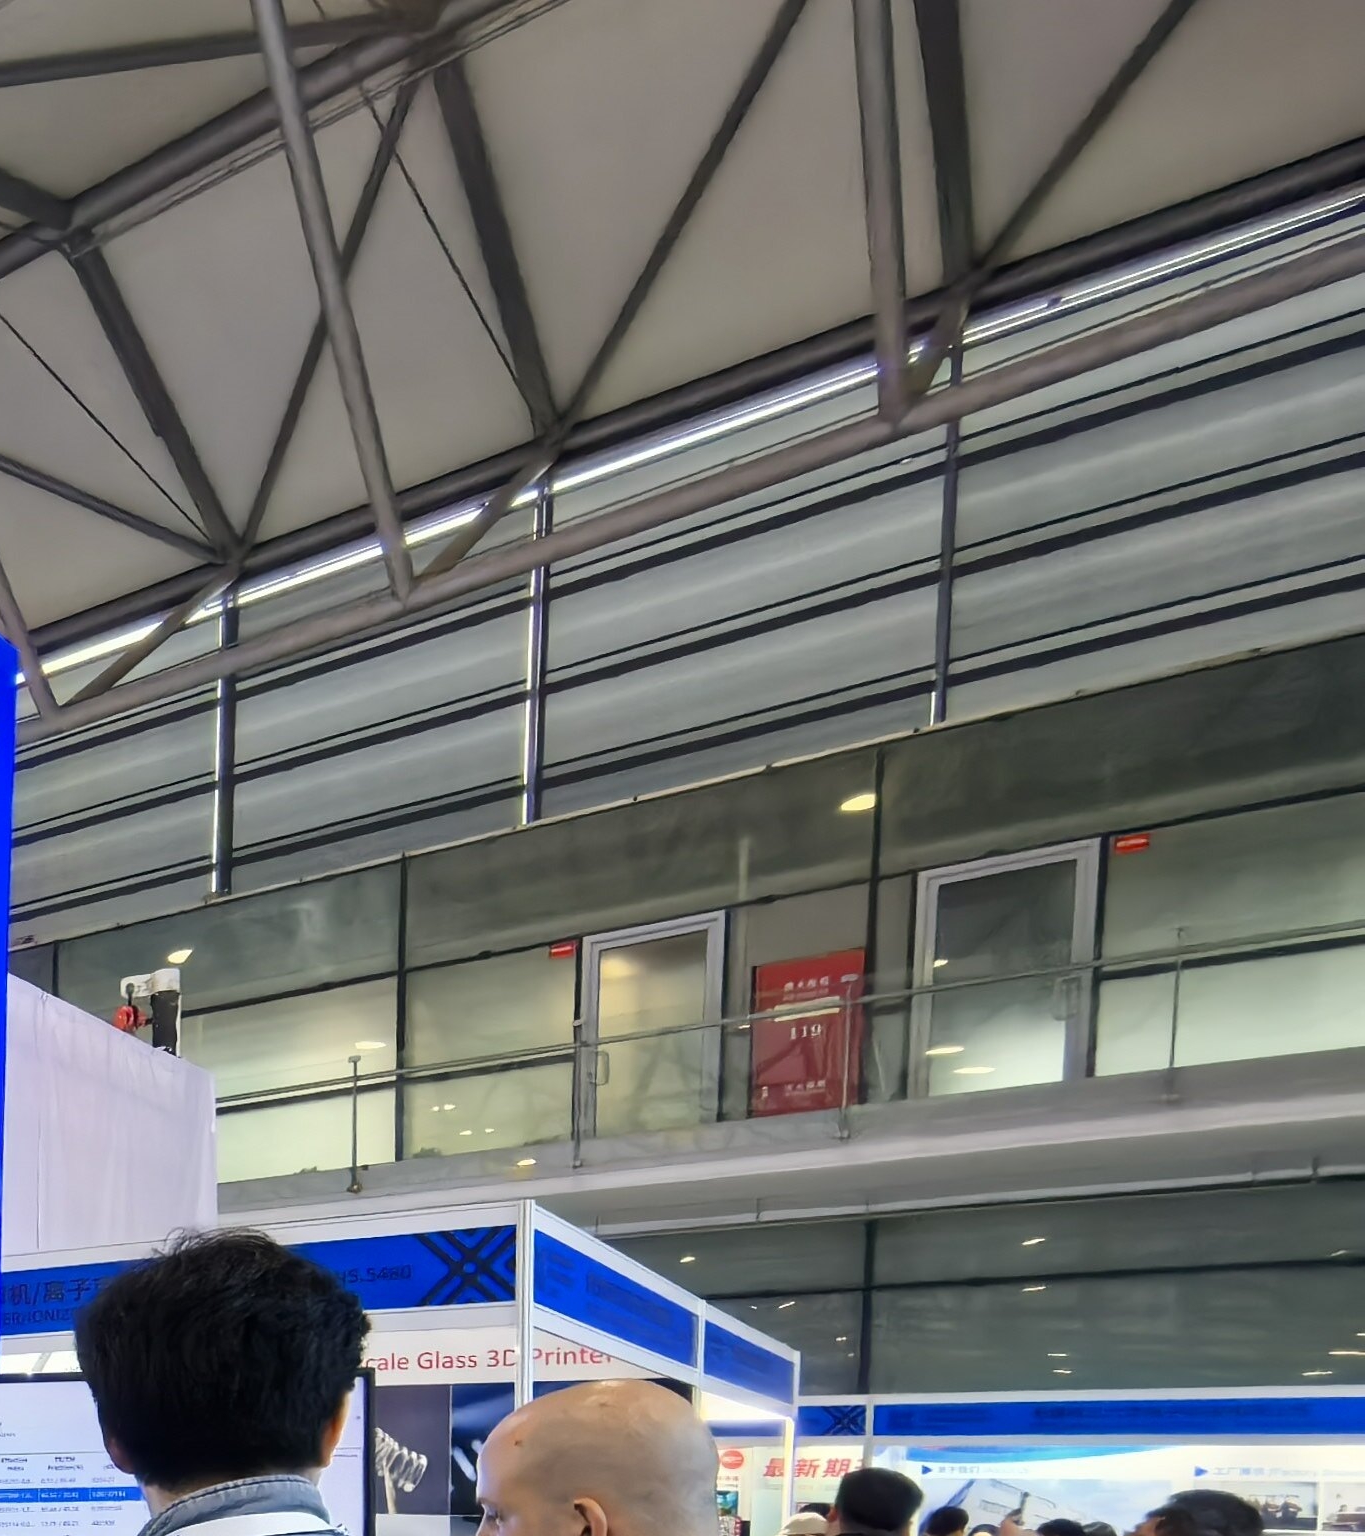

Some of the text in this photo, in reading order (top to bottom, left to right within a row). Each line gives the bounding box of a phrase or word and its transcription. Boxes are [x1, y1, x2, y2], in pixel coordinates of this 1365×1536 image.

[790, 1024, 822, 1040] 119
[417, 1350, 477, 1370] Glass
[486, 1349, 516, 1368] 3D
